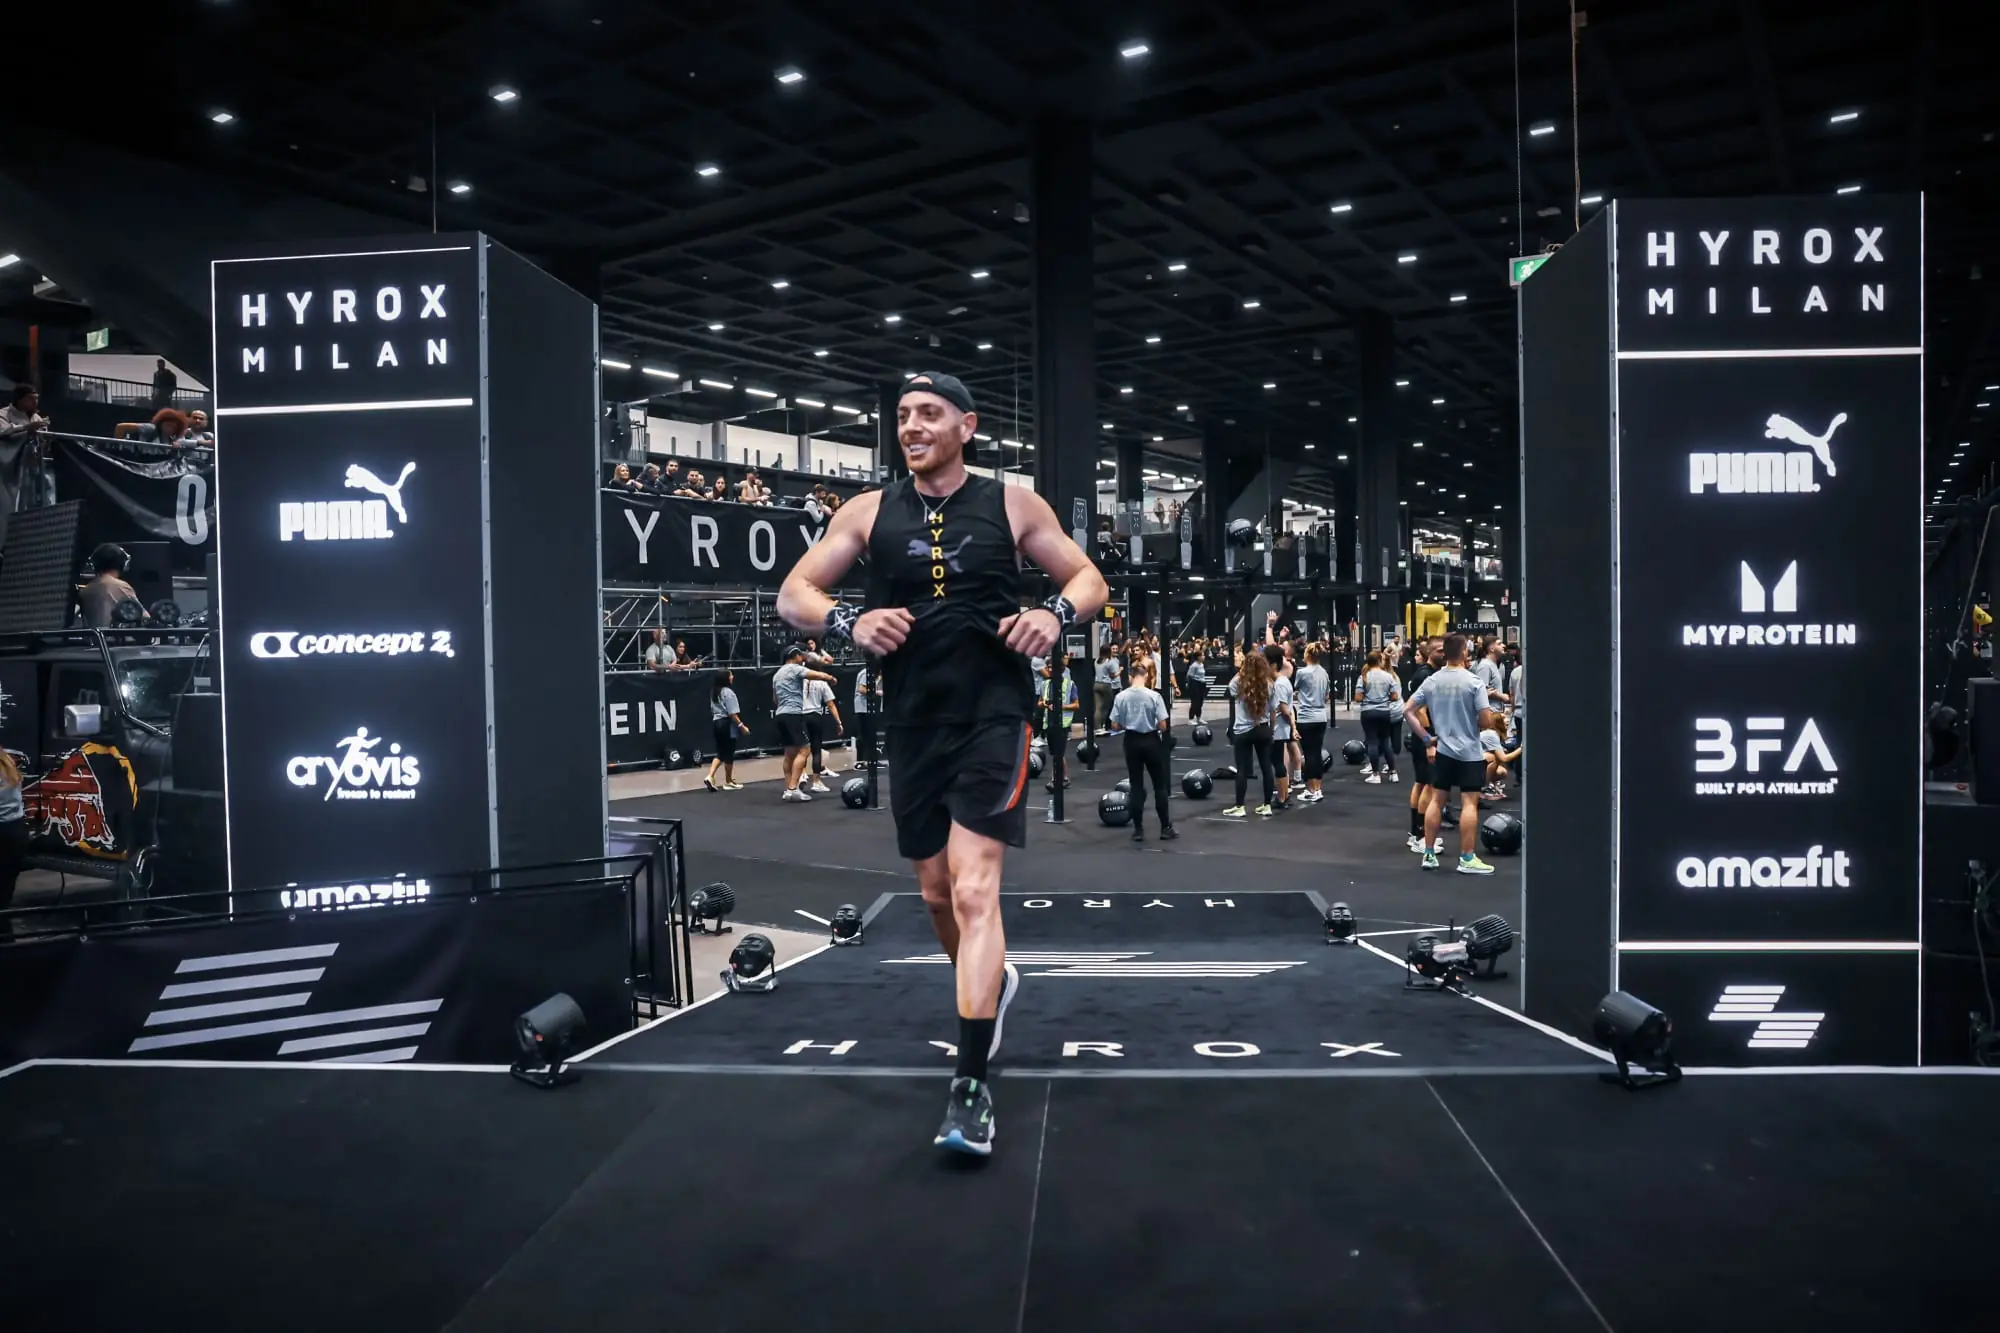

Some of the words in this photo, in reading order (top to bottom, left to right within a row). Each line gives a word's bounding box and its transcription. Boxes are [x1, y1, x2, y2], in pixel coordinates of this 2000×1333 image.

[1648, 227, 1883, 266] HYROX
[241, 284, 447, 327] HYROX
[1648, 285, 1884, 314] MILAN
[242, 339, 447, 373] MILAN
[1689, 452, 1818, 493] PUMA
[280, 500, 391, 541] PUMA
[931, 512, 945, 597] HYROX
[298, 632, 425, 656] concept
[1683, 624, 1856, 645] MYPROTEIN
[1696, 718, 1838, 772] BFA
[287, 743, 421, 801] cryovis
[1676, 845, 1849, 887] amazfit
[1023, 898, 1236, 908] HYRO
